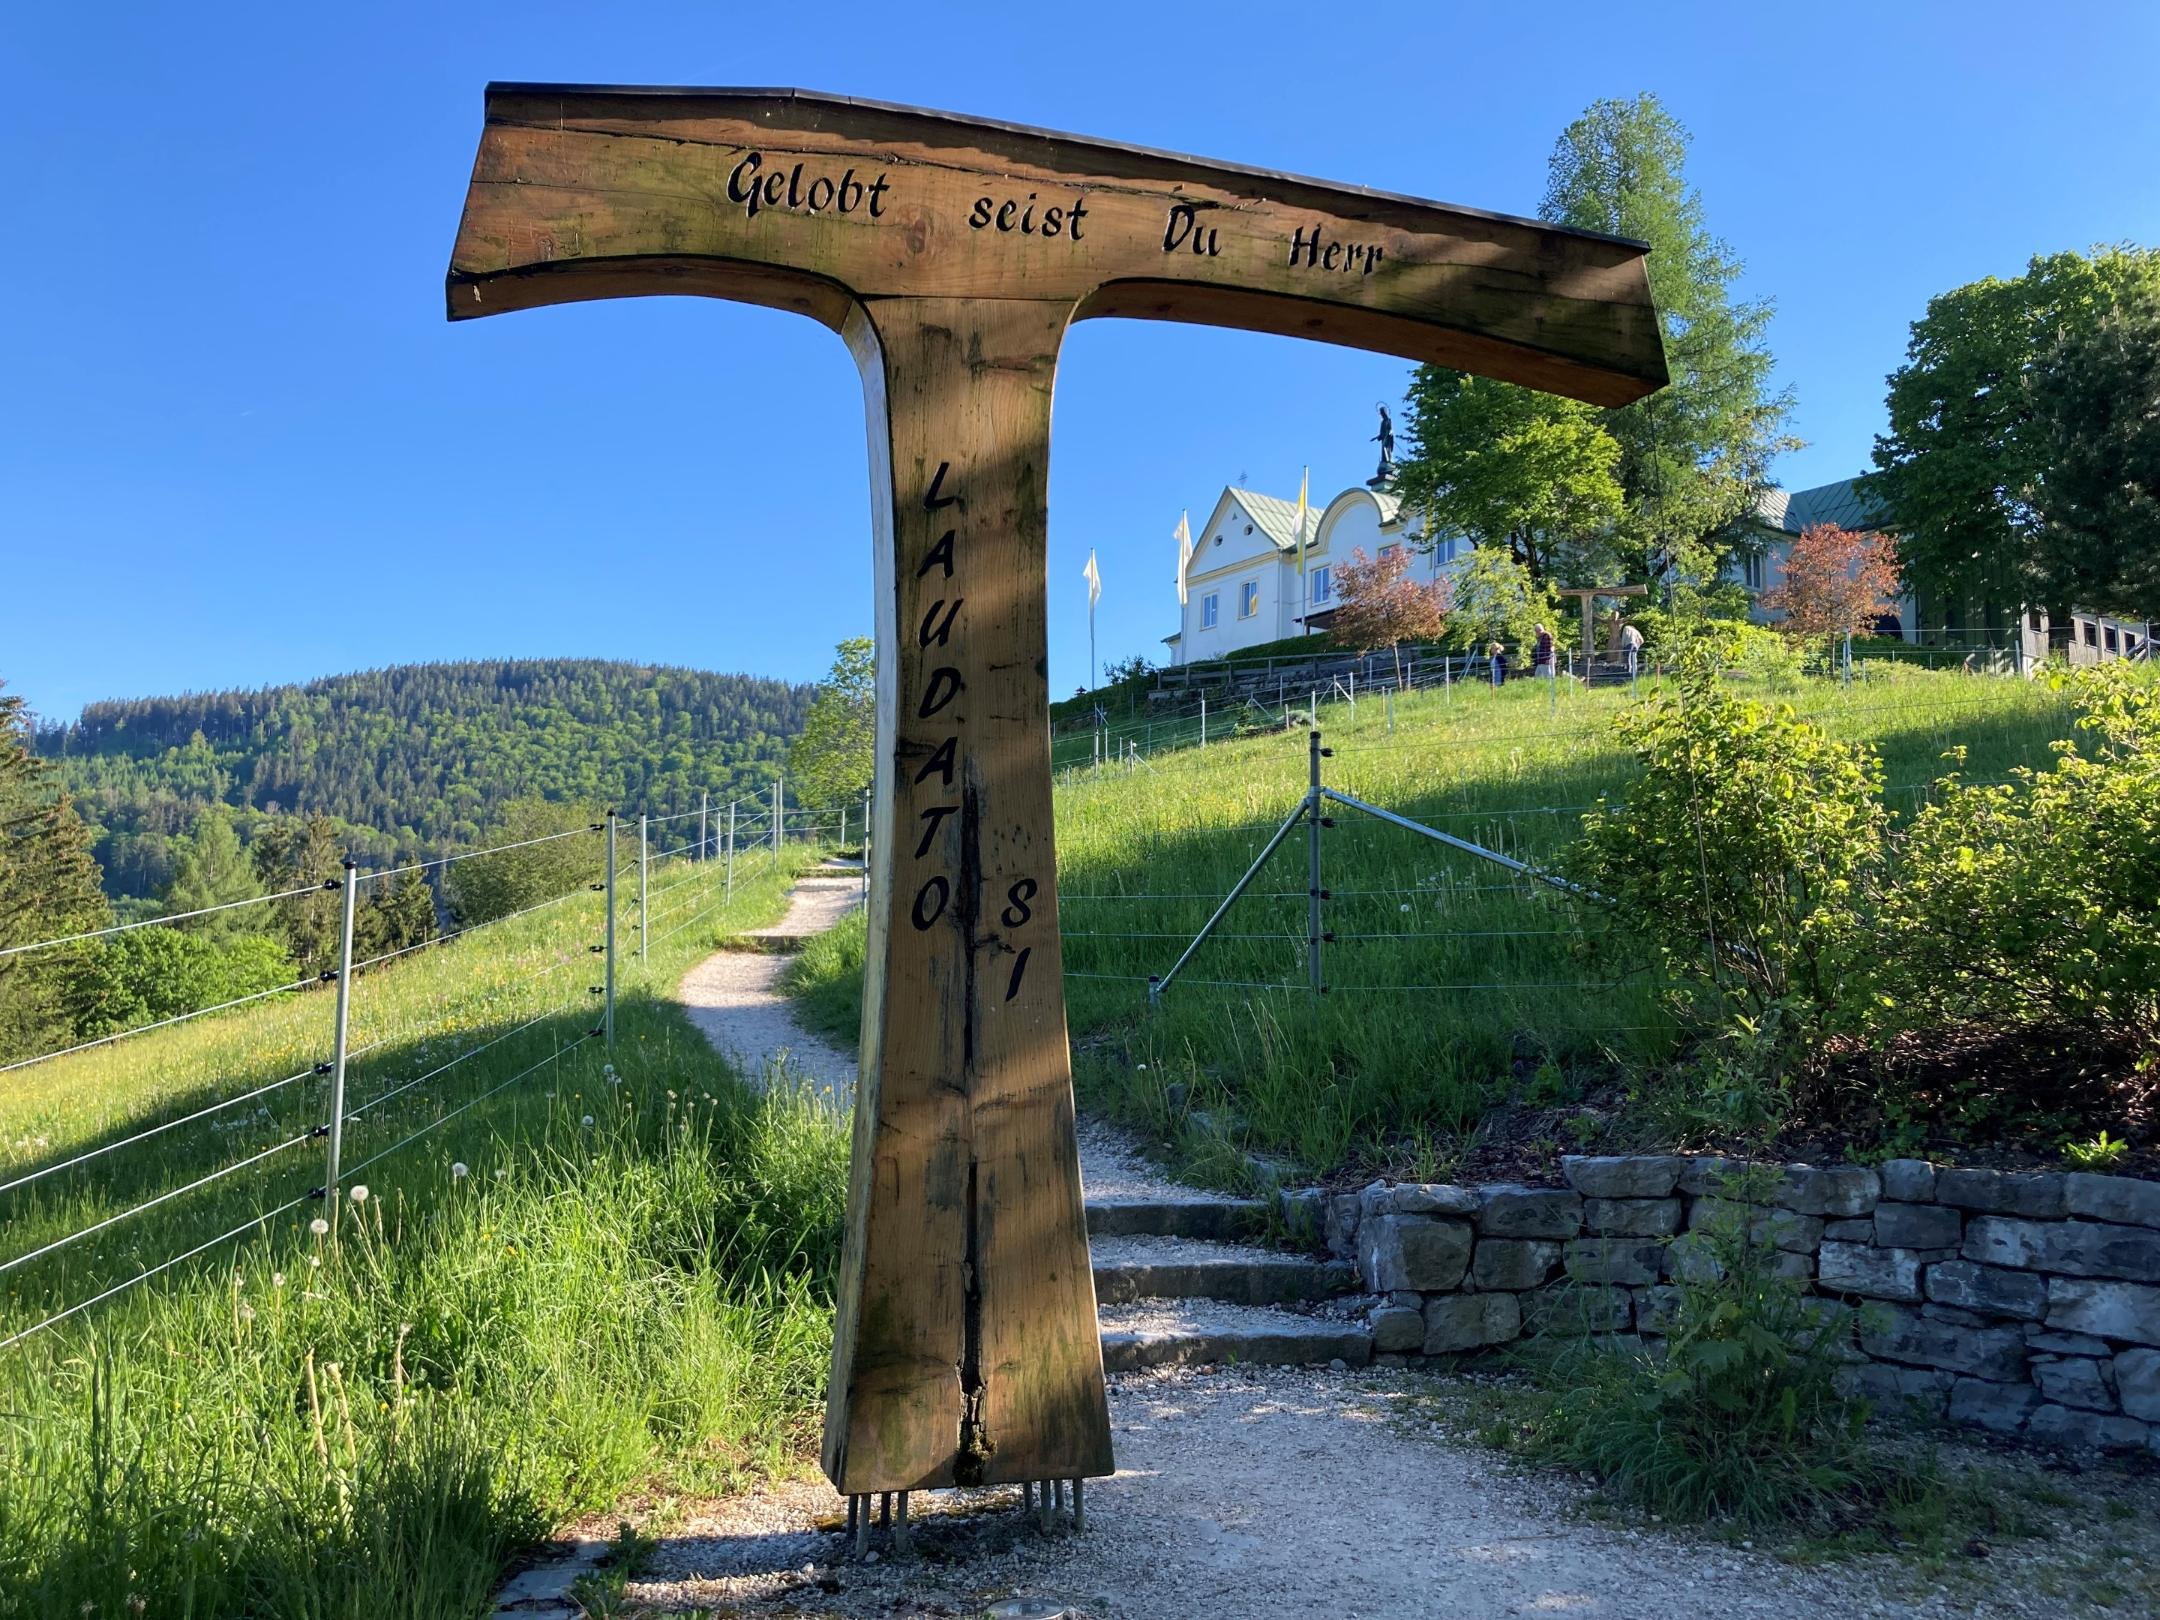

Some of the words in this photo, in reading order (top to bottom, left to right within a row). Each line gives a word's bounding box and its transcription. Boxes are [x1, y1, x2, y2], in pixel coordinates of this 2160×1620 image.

[726, 151, 891, 219] Gelobt
[967, 192, 1089, 241] seist
[1162, 203, 1222, 257] Du
[1288, 223, 1384, 276] Herr
[911, 461, 964, 932] LAUDATO
[1001, 877, 1038, 1002] SI
